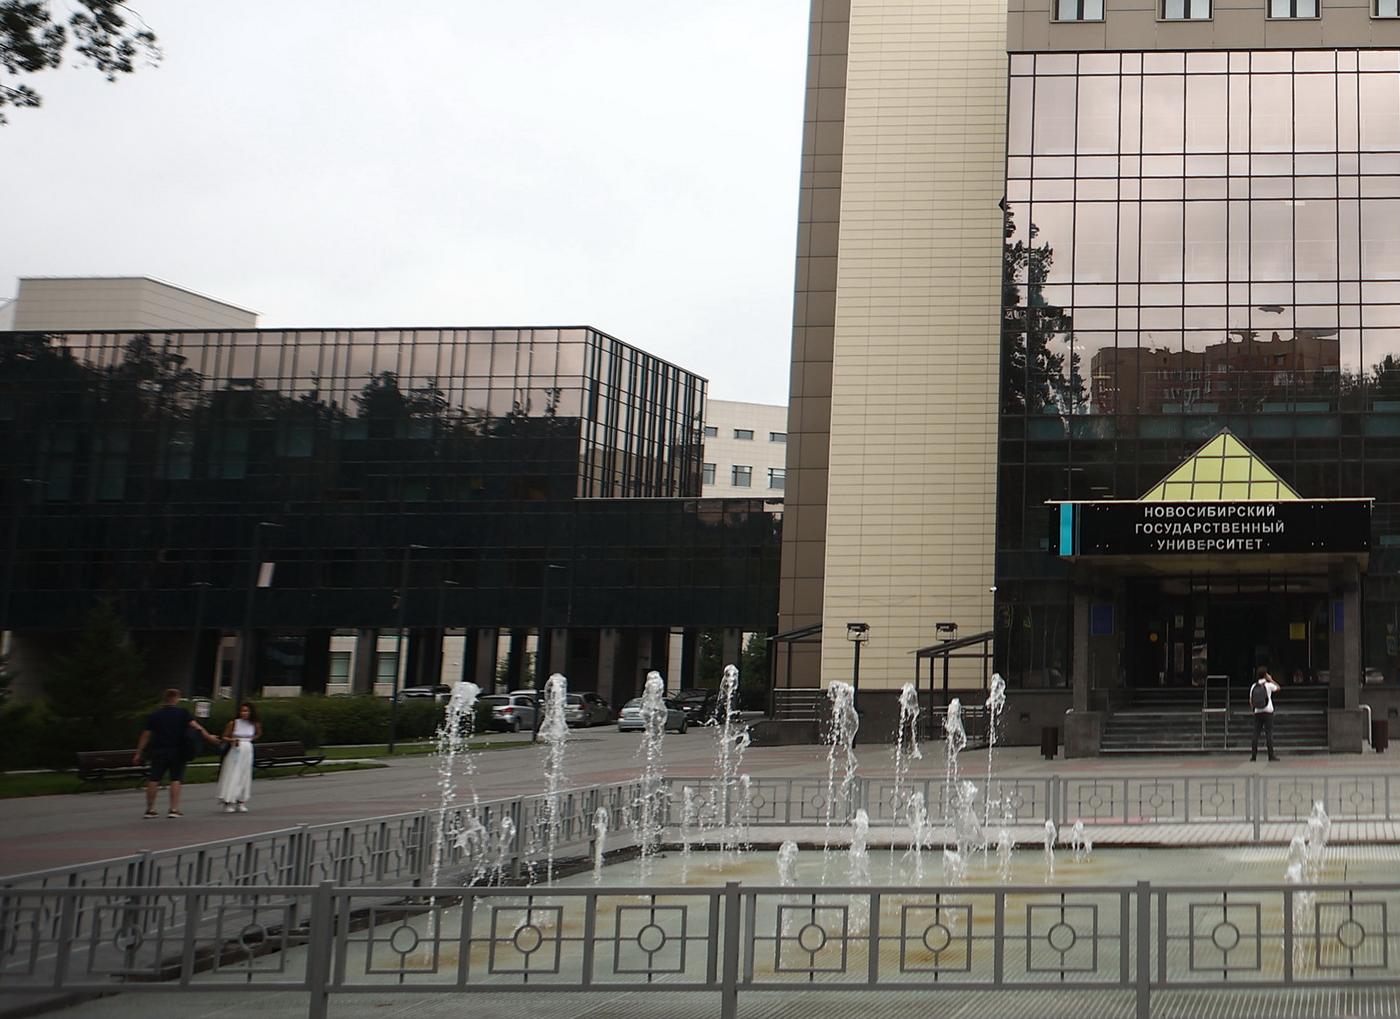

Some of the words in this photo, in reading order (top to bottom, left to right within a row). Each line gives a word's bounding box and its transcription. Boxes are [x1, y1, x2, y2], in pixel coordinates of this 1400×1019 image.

[1144, 504, 1276, 518] НОВОСИБИРСКИЙ
[1135, 521, 1285, 535] ГОСУДАРСТВЕННЫЙ
[1157, 538, 1264, 551] УНИВЕРСИТЕТ
